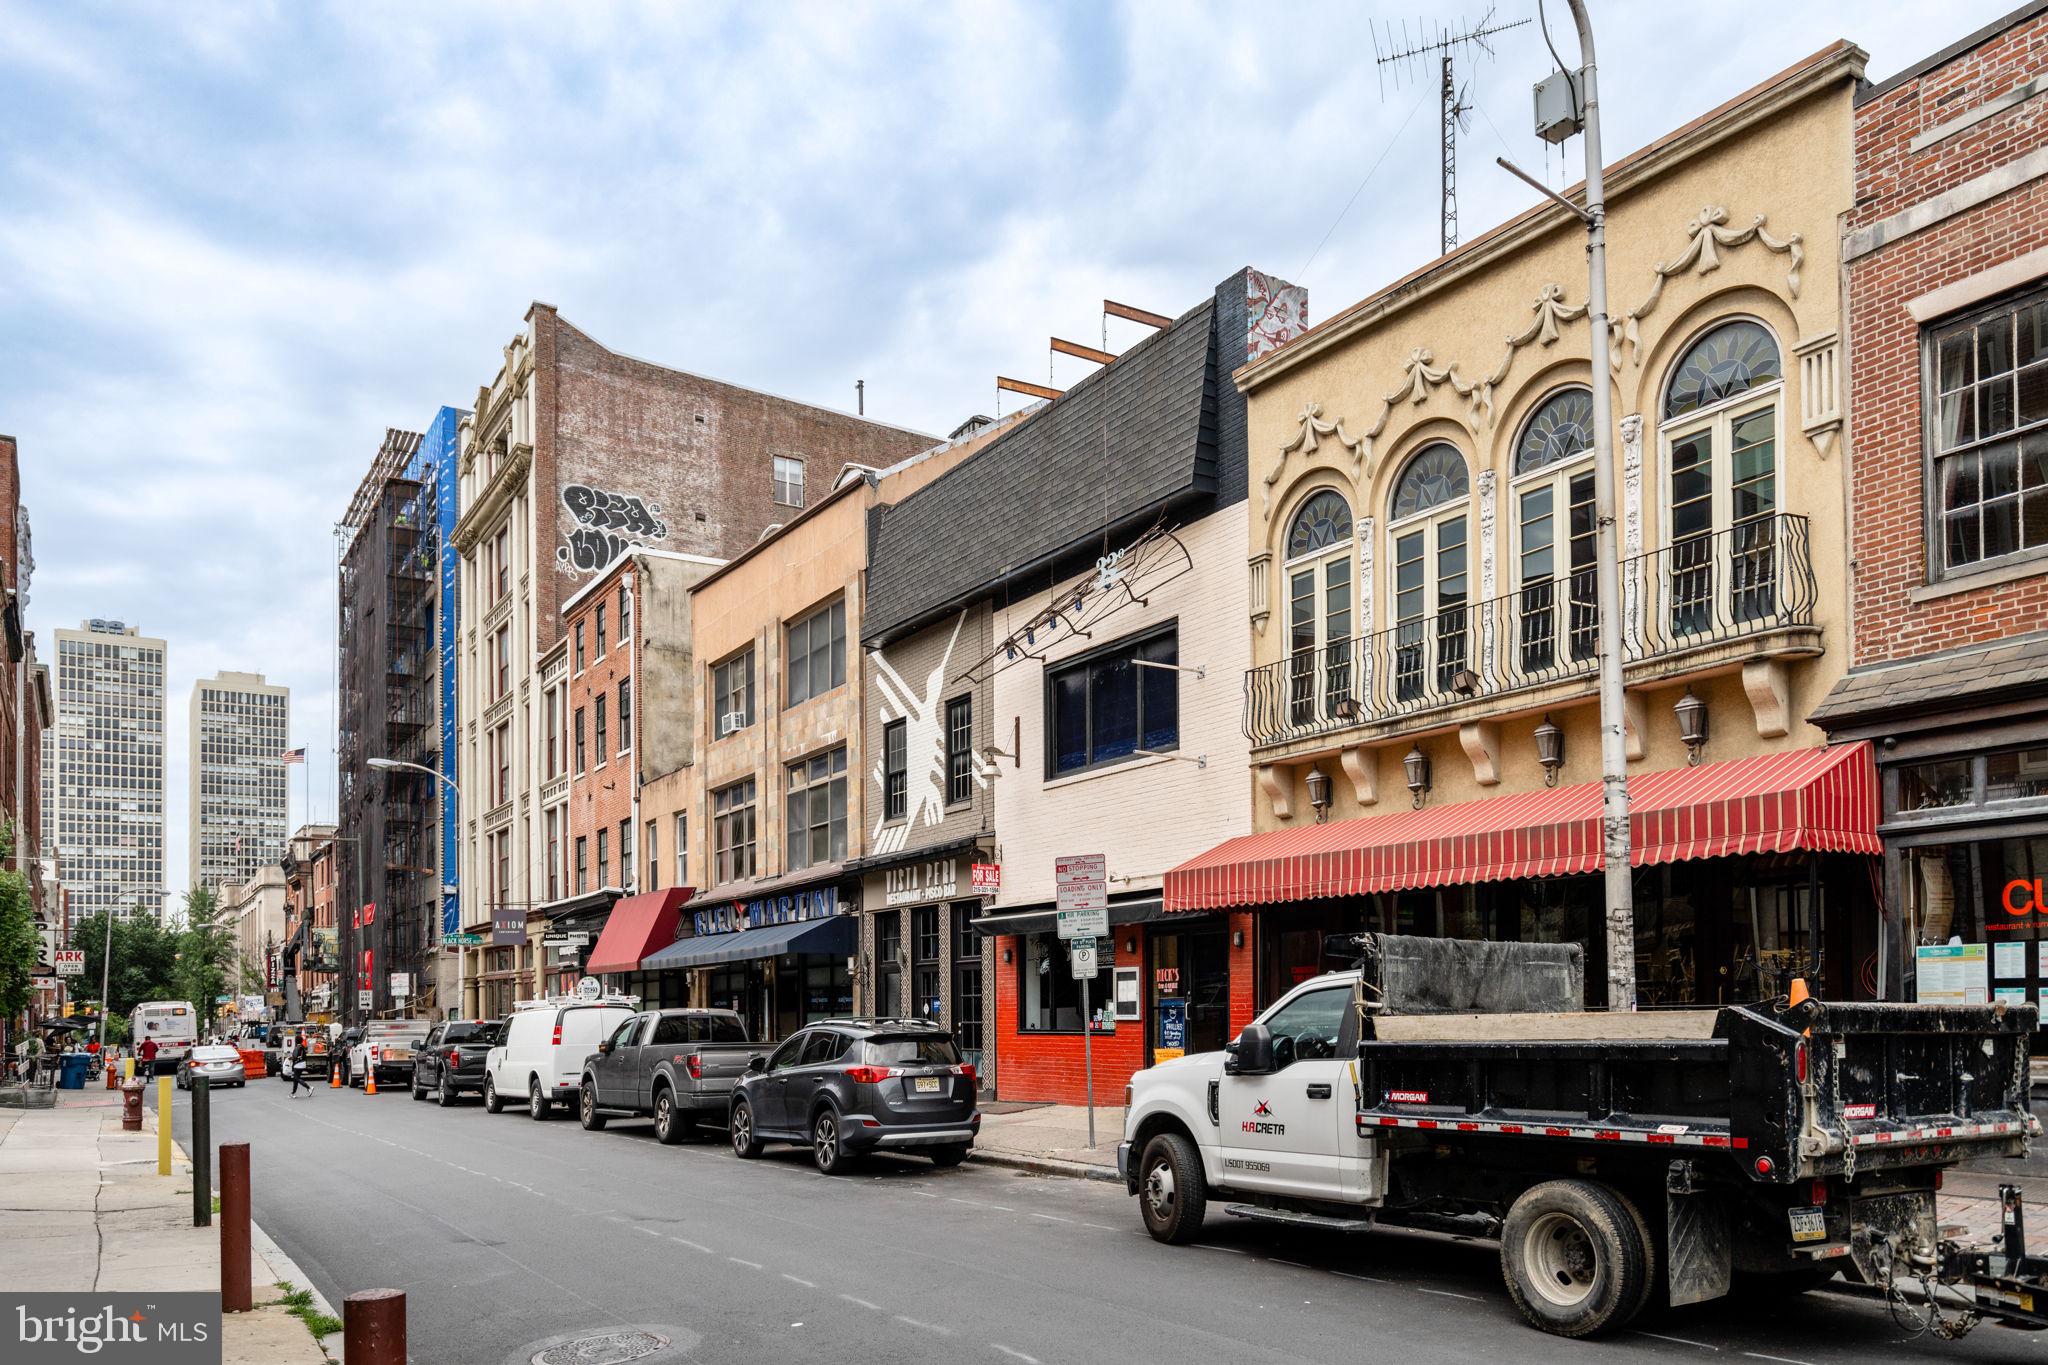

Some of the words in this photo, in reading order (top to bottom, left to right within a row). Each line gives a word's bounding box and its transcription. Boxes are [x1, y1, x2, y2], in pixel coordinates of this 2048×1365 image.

[1068, 863, 1098, 872] STOPPING
[886, 866, 919, 893] VISTA
[926, 858, 956, 887] PERU
[973, 869, 984, 881] FOR
[985, 869, 999, 883] SALE
[943, 882, 957, 897] BAR
[1060, 884, 1086, 893] LOADING
[1087, 883, 1103, 891] ONLY
[749, 886, 839, 927] MARTINI
[1076, 910, 1100, 918] PARKING
[495, 920, 525, 930] AXIOM
[1984, 921, 2024, 931] restaurant
[442, 937, 458, 946] BLACK
[1156, 967, 1180, 982] NICK'S
[1391, 1092, 1427, 1102] MORGAN
[1843, 1105, 1875, 1118] MORGAN
[1225, 1158, 1244, 1169] USDOT
